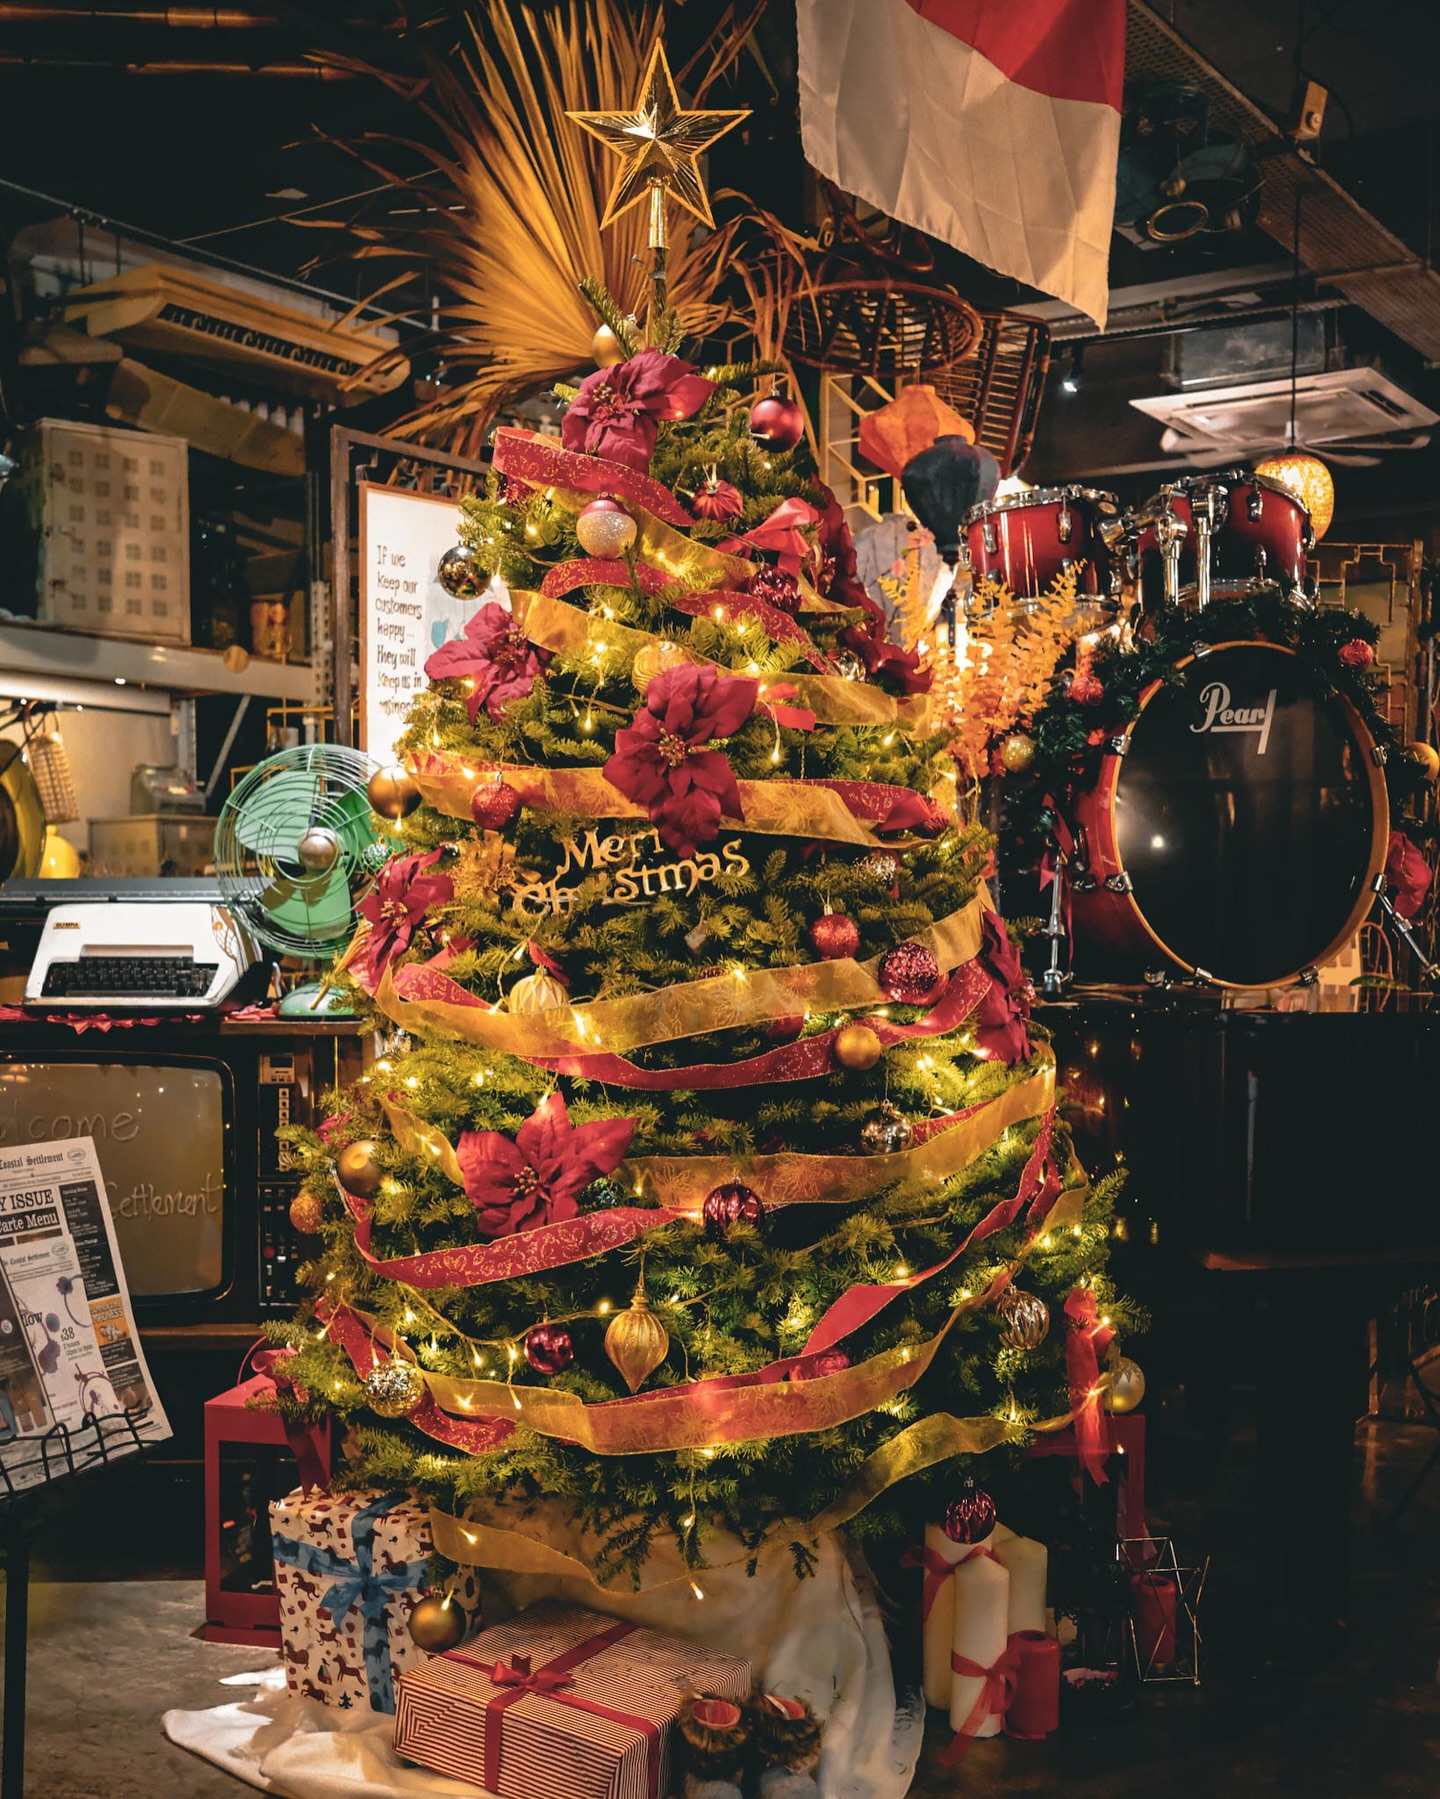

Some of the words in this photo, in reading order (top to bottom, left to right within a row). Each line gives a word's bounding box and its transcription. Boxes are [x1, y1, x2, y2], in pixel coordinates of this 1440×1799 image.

[377, 545, 388, 565] If
[391, 553, 406, 567] we
[402, 580, 419, 594] our
[375, 597, 423, 620] customers
[377, 644, 398, 670] they
[399, 648, 416, 667] will
[401, 675, 411, 689] us
[414, 671, 422, 688] in
[1190, 682, 1277, 754] Pearl
[26, 1153, 64, 1167] Settlement
[9, 1189, 54, 1210] ISSUE
[25, 1212, 58, 1229] Menu
